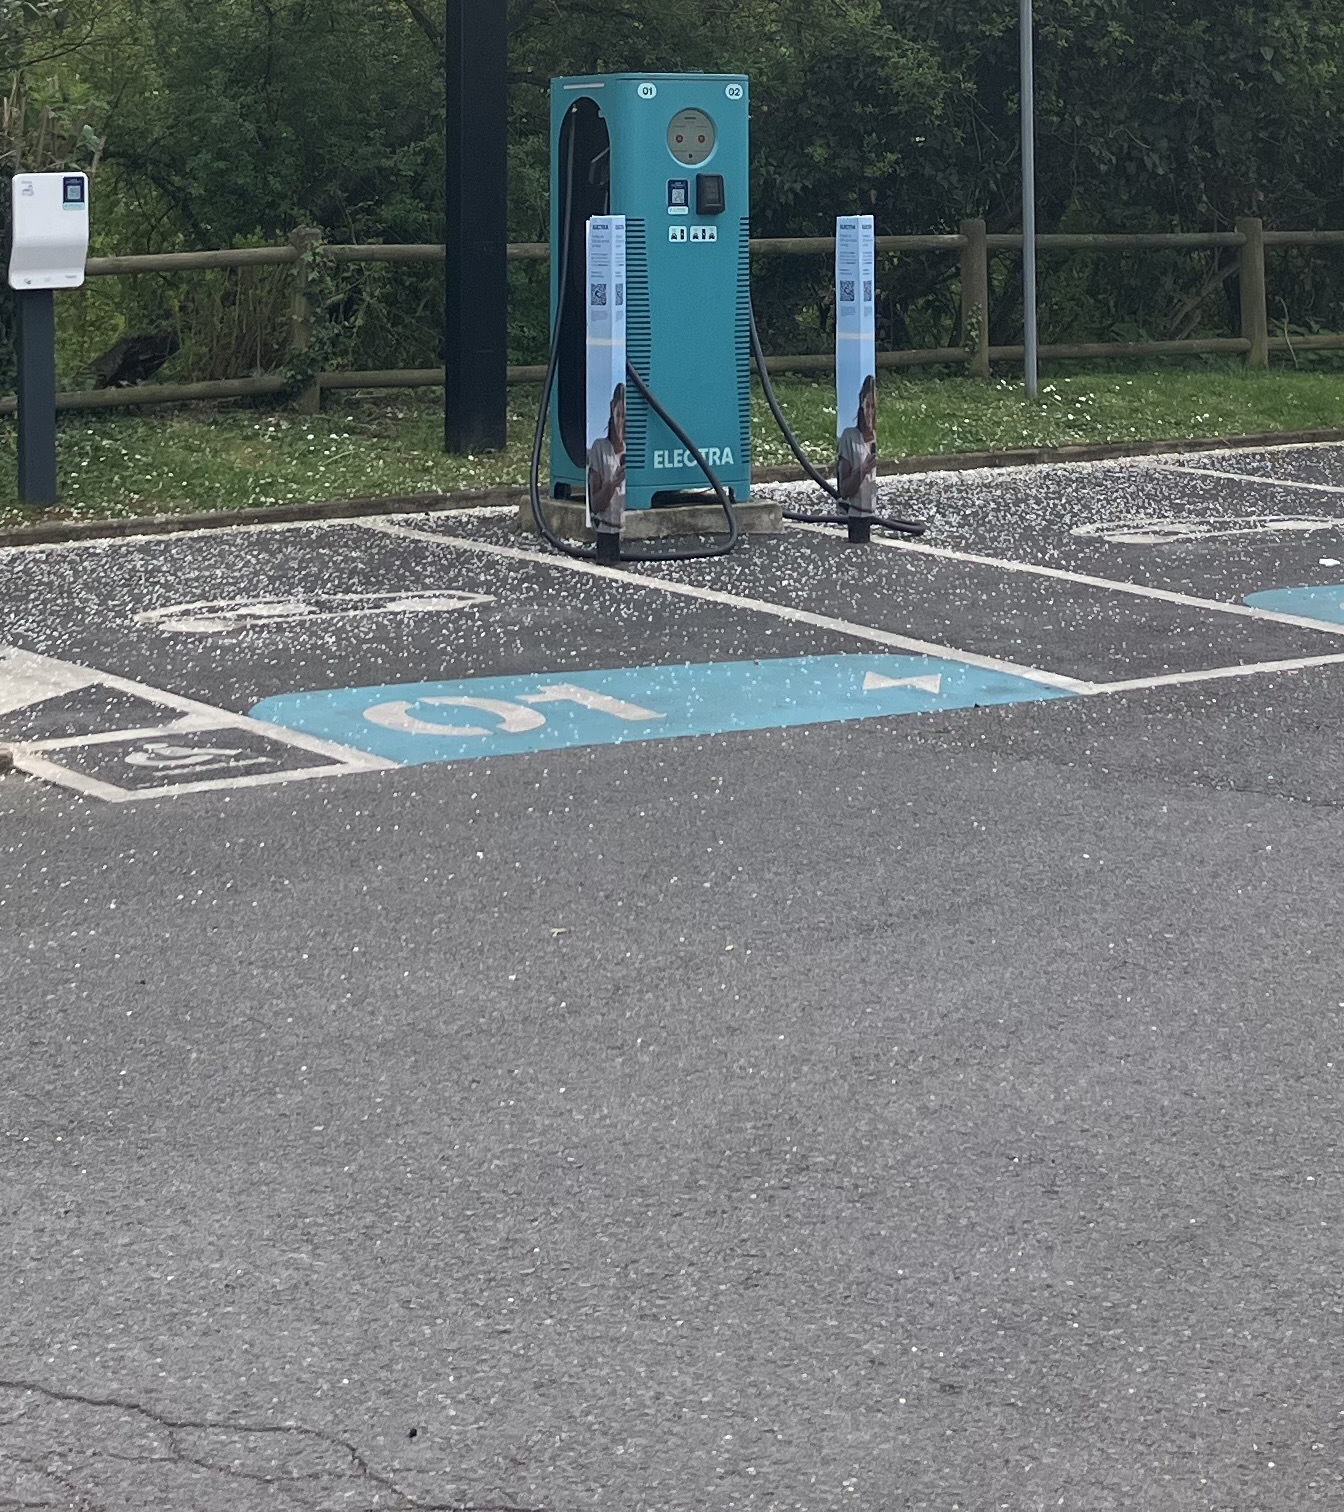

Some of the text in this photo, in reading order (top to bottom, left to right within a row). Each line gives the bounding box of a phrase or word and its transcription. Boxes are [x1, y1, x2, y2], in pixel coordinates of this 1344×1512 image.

[642, 87, 653, 95] 01
[728, 87, 741, 96] 02
[362, 684, 668, 736] 01
